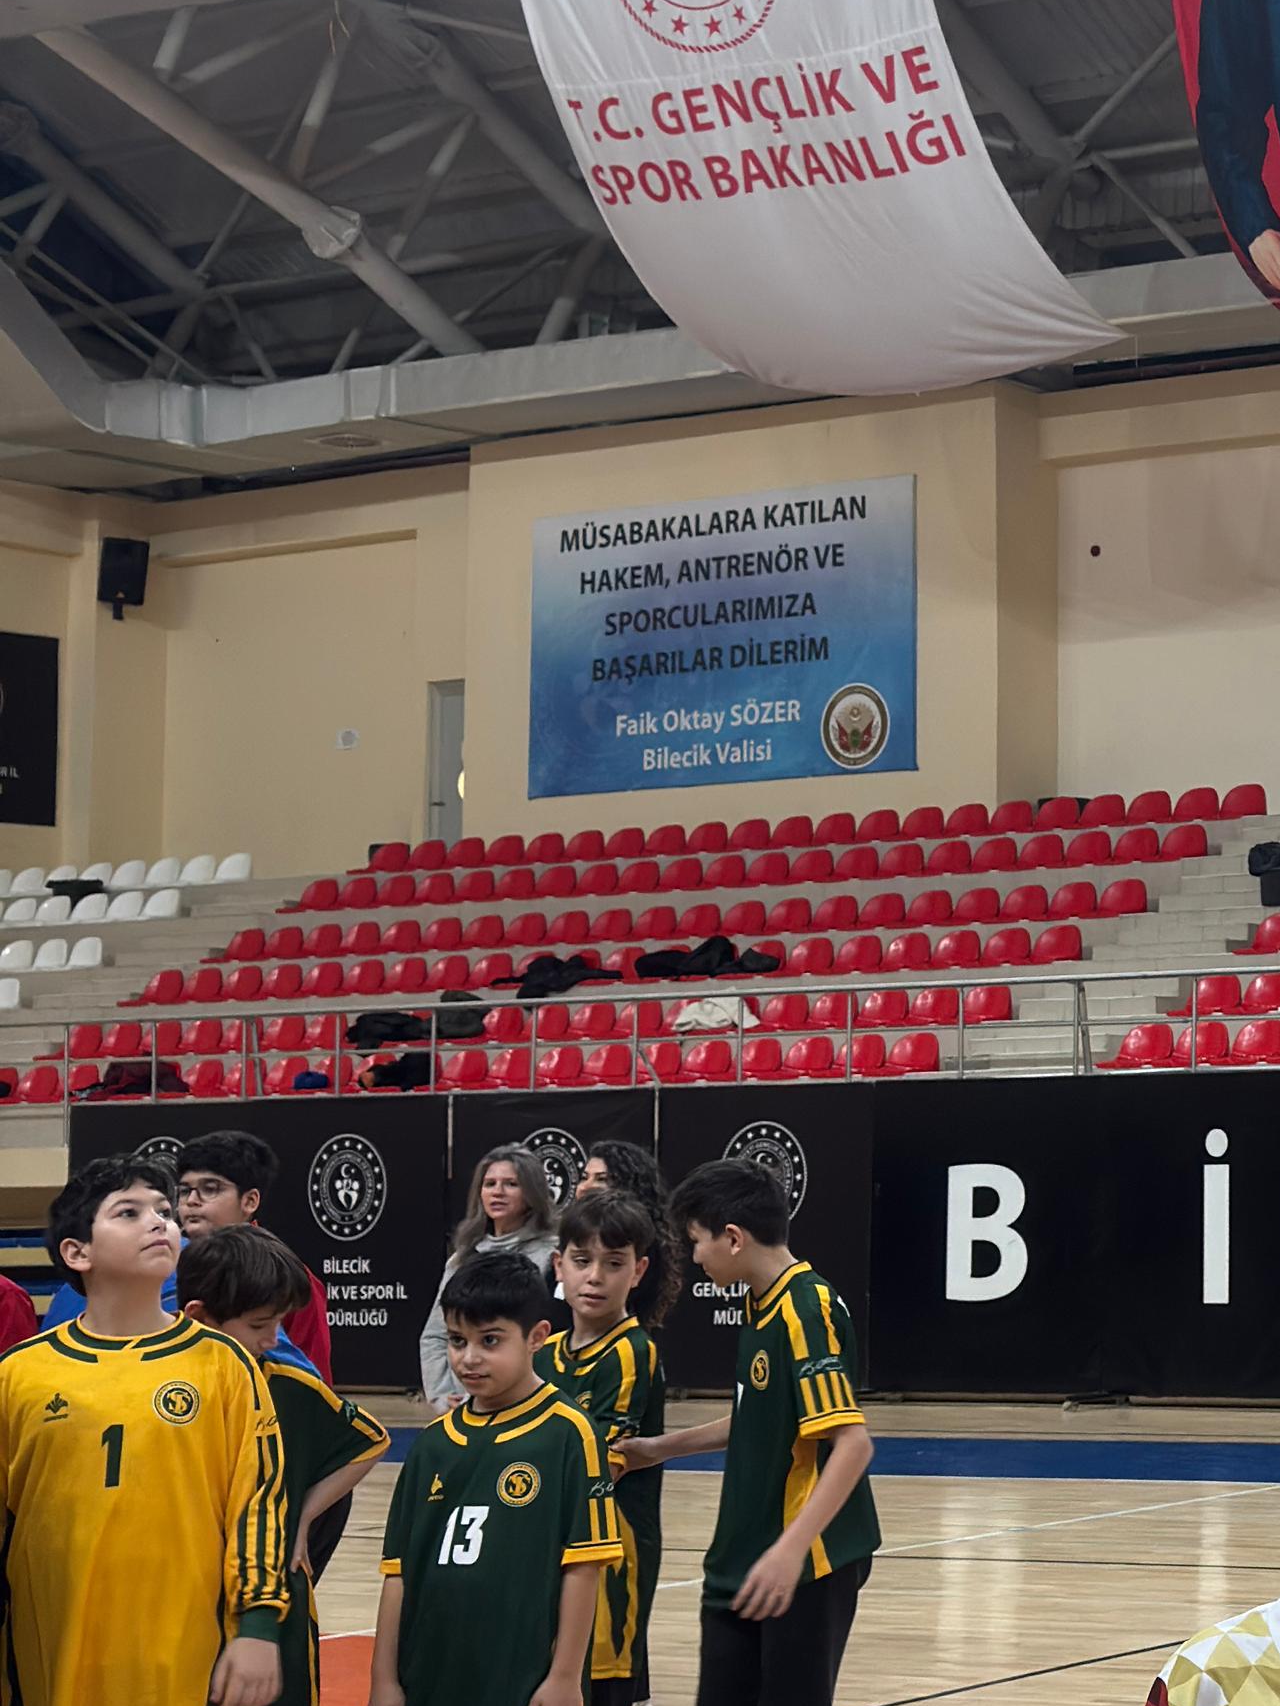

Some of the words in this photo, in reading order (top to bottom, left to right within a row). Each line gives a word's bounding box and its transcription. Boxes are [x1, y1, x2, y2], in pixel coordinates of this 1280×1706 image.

[651, 62, 856, 133] GENÇLİK
[861, 44, 939, 105] VE
[590, 157, 702, 207] SPOR
[703, 110, 968, 198] BAKANLIĞI
[559, 506, 757, 553] MÜSABAKALARA
[763, 494, 868, 529] KATILAN
[579, 562, 671, 595] HAKEM,
[677, 543, 810, 584] ANTRENÖR
[814, 542, 846, 568] VE
[604, 591, 817, 636] SPORCULARIMIZA
[590, 647, 724, 685] BAŞARILAR
[730, 635, 830, 669] DİLERİM
[615, 712, 658, 737] Faik
[663, 705, 726, 736] Oktay
[730, 698, 802, 727] SÖZER
[642, 745, 712, 771] Bilecik
[715, 739, 773, 764] Valisi
[323, 1256, 370, 1274] BİLECİK
[341, 1285, 358, 1300] VE
[360, 1285, 394, 1300] SPOR
[396, 1282, 408, 1300] İL
[327, 1308, 388, 1327] DÜRLÜĞÜ
[101, 1424, 124, 1488] 1
[437, 1505, 490, 1566] 13
